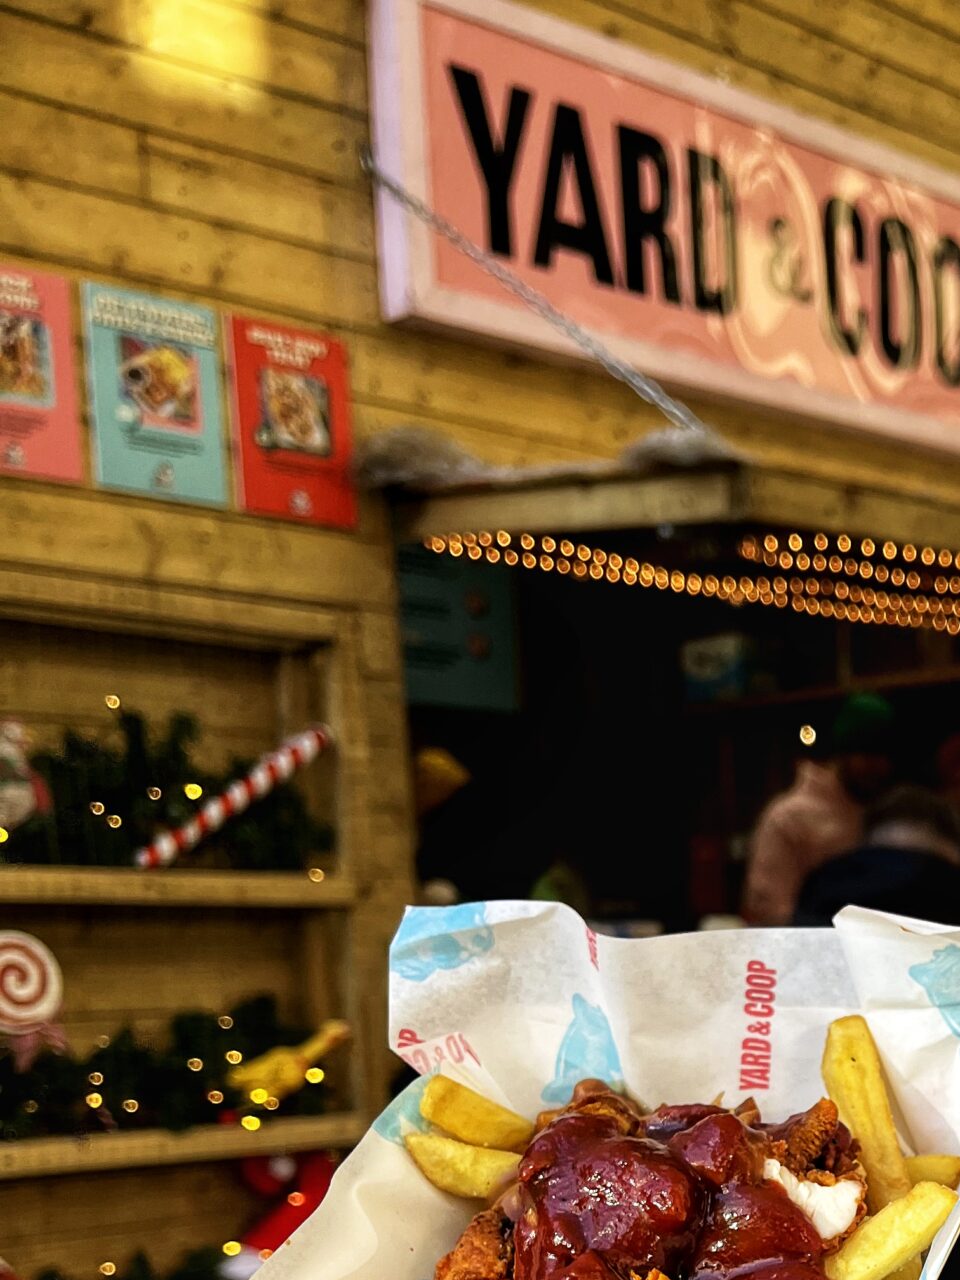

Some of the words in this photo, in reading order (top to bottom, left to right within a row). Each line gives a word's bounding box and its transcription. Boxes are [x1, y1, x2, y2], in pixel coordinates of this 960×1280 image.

[445, 62, 736, 318] YARD
[767, 215, 814, 303] &
[744, 959, 777, 1018] COOP
[747, 1021, 771, 1036] &
[739, 1037, 772, 1090] YARD
